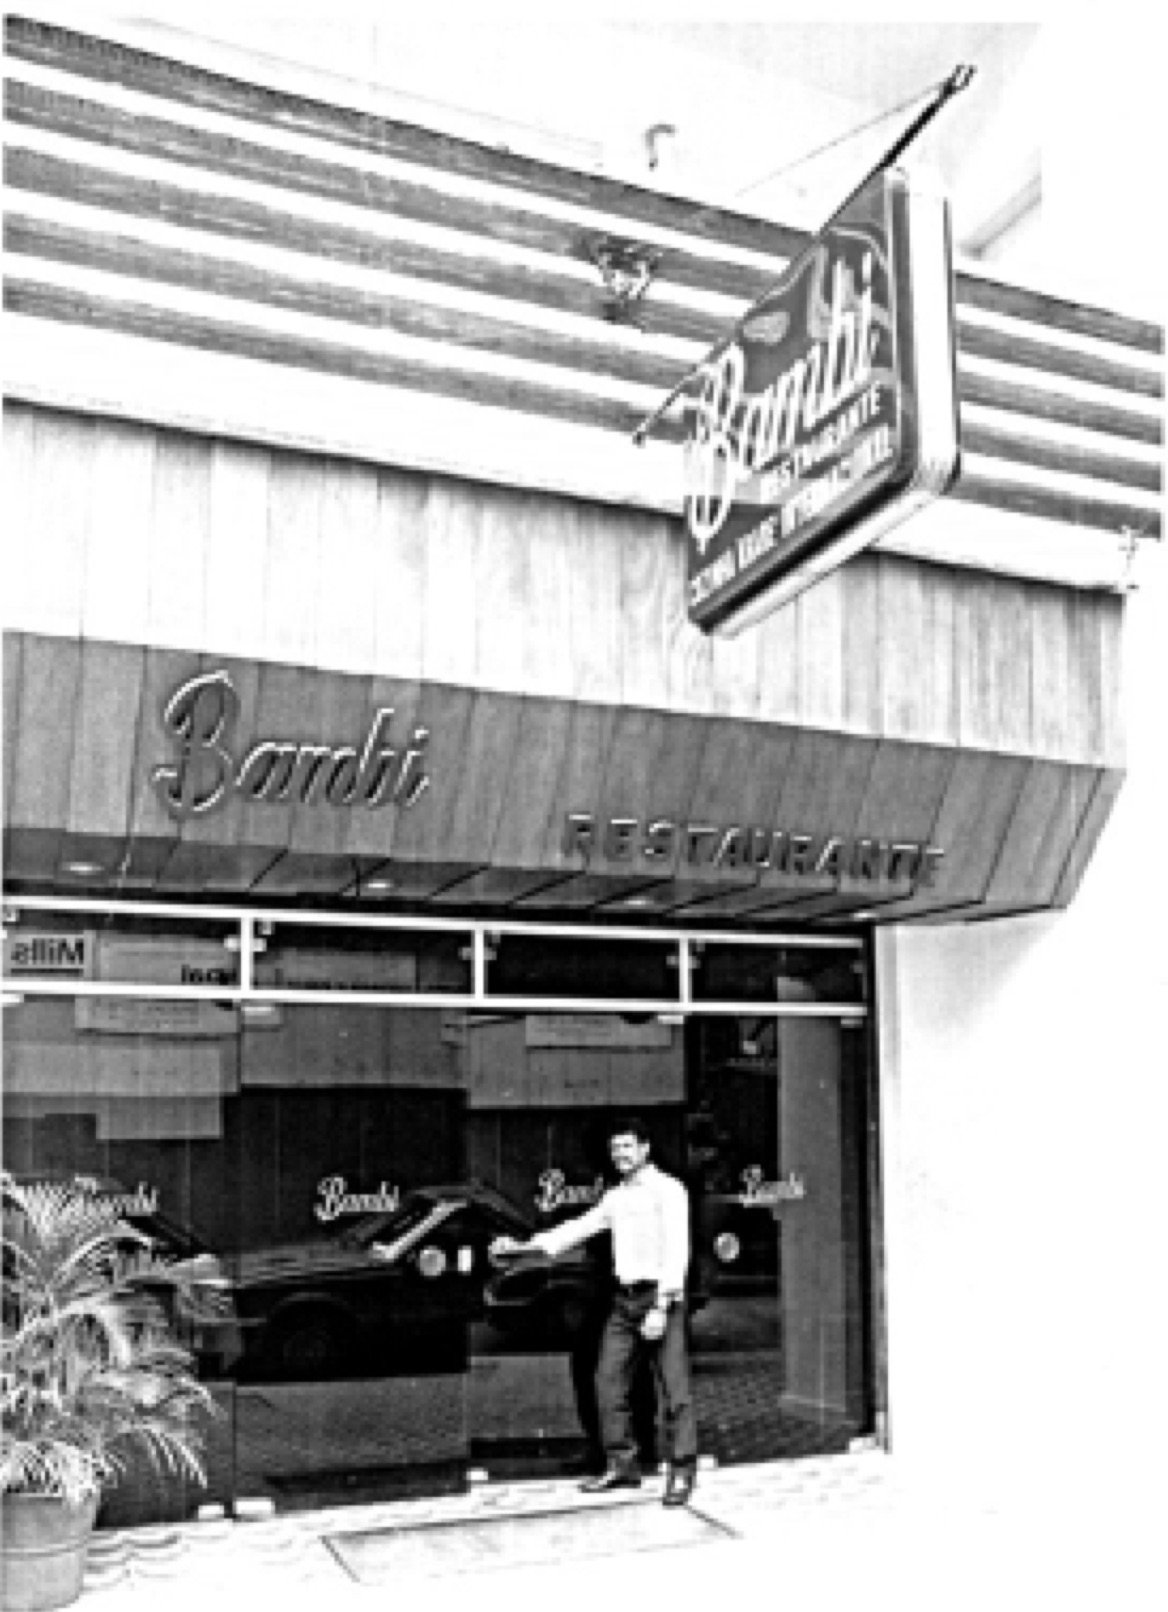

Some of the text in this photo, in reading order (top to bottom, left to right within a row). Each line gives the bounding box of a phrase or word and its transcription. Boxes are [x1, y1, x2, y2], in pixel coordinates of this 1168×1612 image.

[688, 252, 881, 556] Bambi
[153, 668, 431, 818] Bambi
[562, 811, 946, 884] RESTAURANTE
[313, 1176, 399, 1221] Bambi
